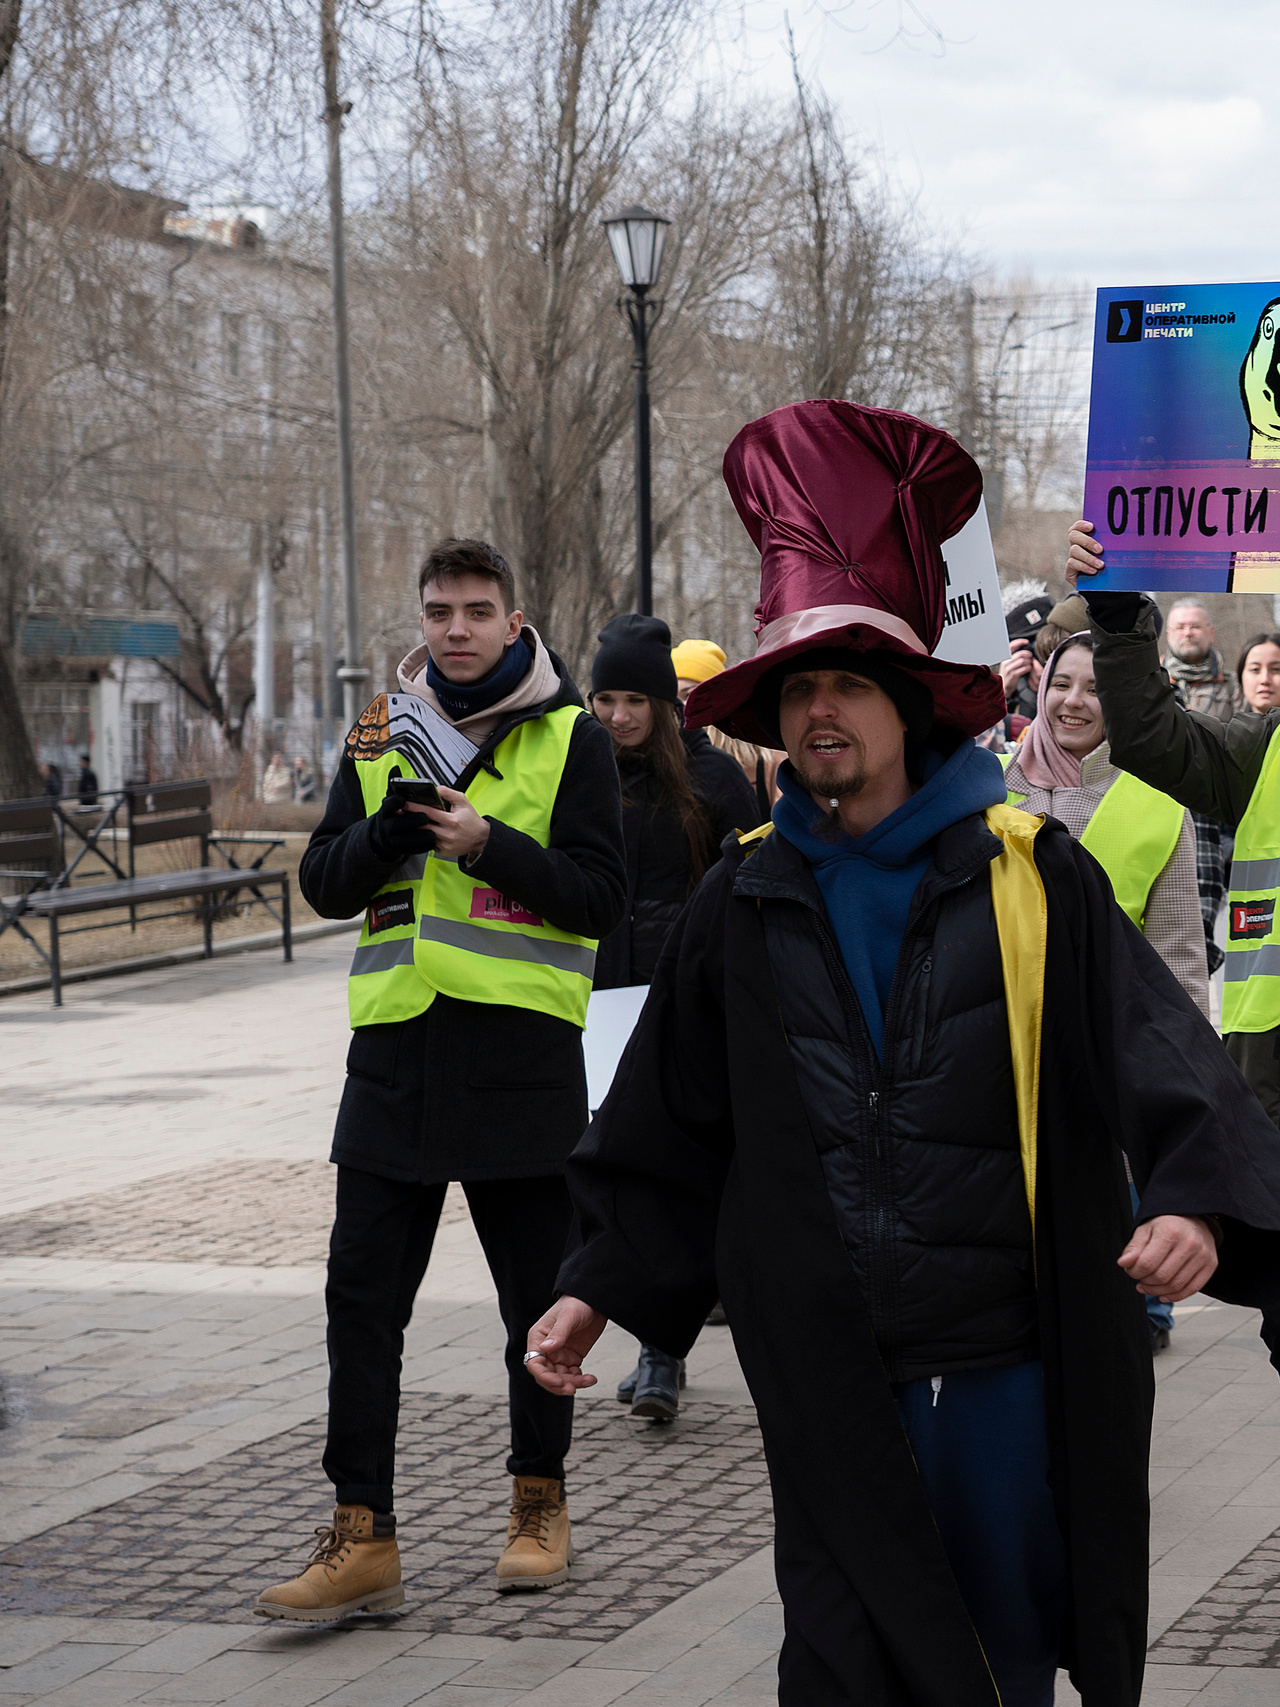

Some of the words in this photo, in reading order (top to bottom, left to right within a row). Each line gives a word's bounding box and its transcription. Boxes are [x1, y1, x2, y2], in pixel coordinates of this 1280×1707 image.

[1145, 302, 1186, 315] ЦЕНТР
[1145, 311, 1236, 326] ОПЕРАТИВНОЙ
[1144, 327, 1193, 338] ПЕЧАТИ
[1107, 485, 1268, 537] ОТПУСТИ
